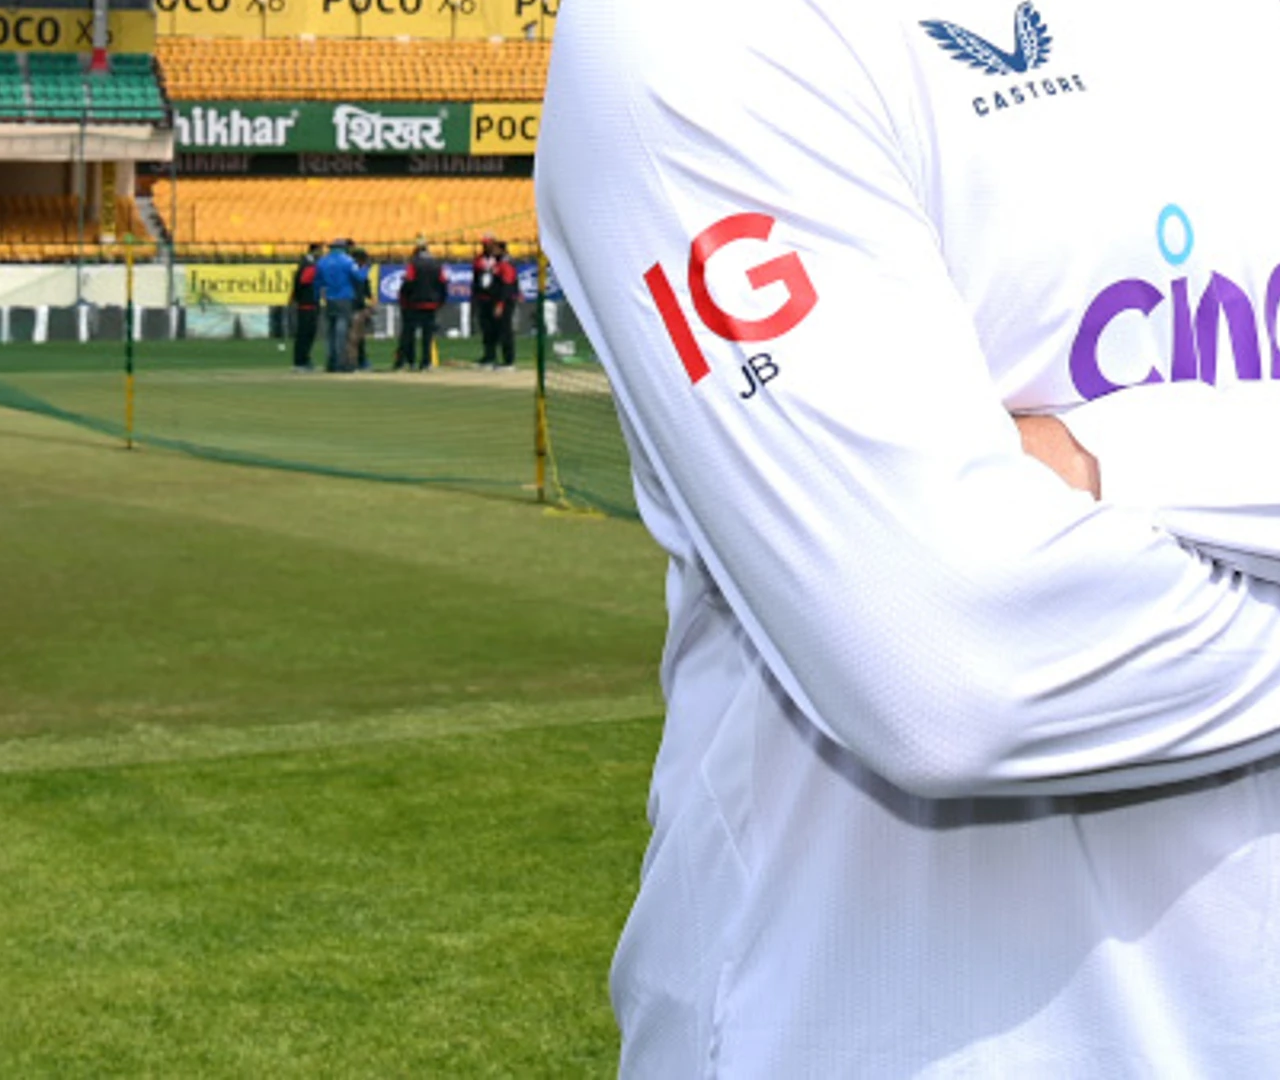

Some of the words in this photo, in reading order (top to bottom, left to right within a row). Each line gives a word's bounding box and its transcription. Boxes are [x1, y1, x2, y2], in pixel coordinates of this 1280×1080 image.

[971, 73, 1087, 118] CASTORE
[173, 105, 295, 148] hikhar
[332, 103, 446, 152] शिखर
[475, 114, 538, 142] POC
[190, 269, 290, 293] Incredib
[642, 210, 820, 387] IG
[739, 352, 781, 400] JB
